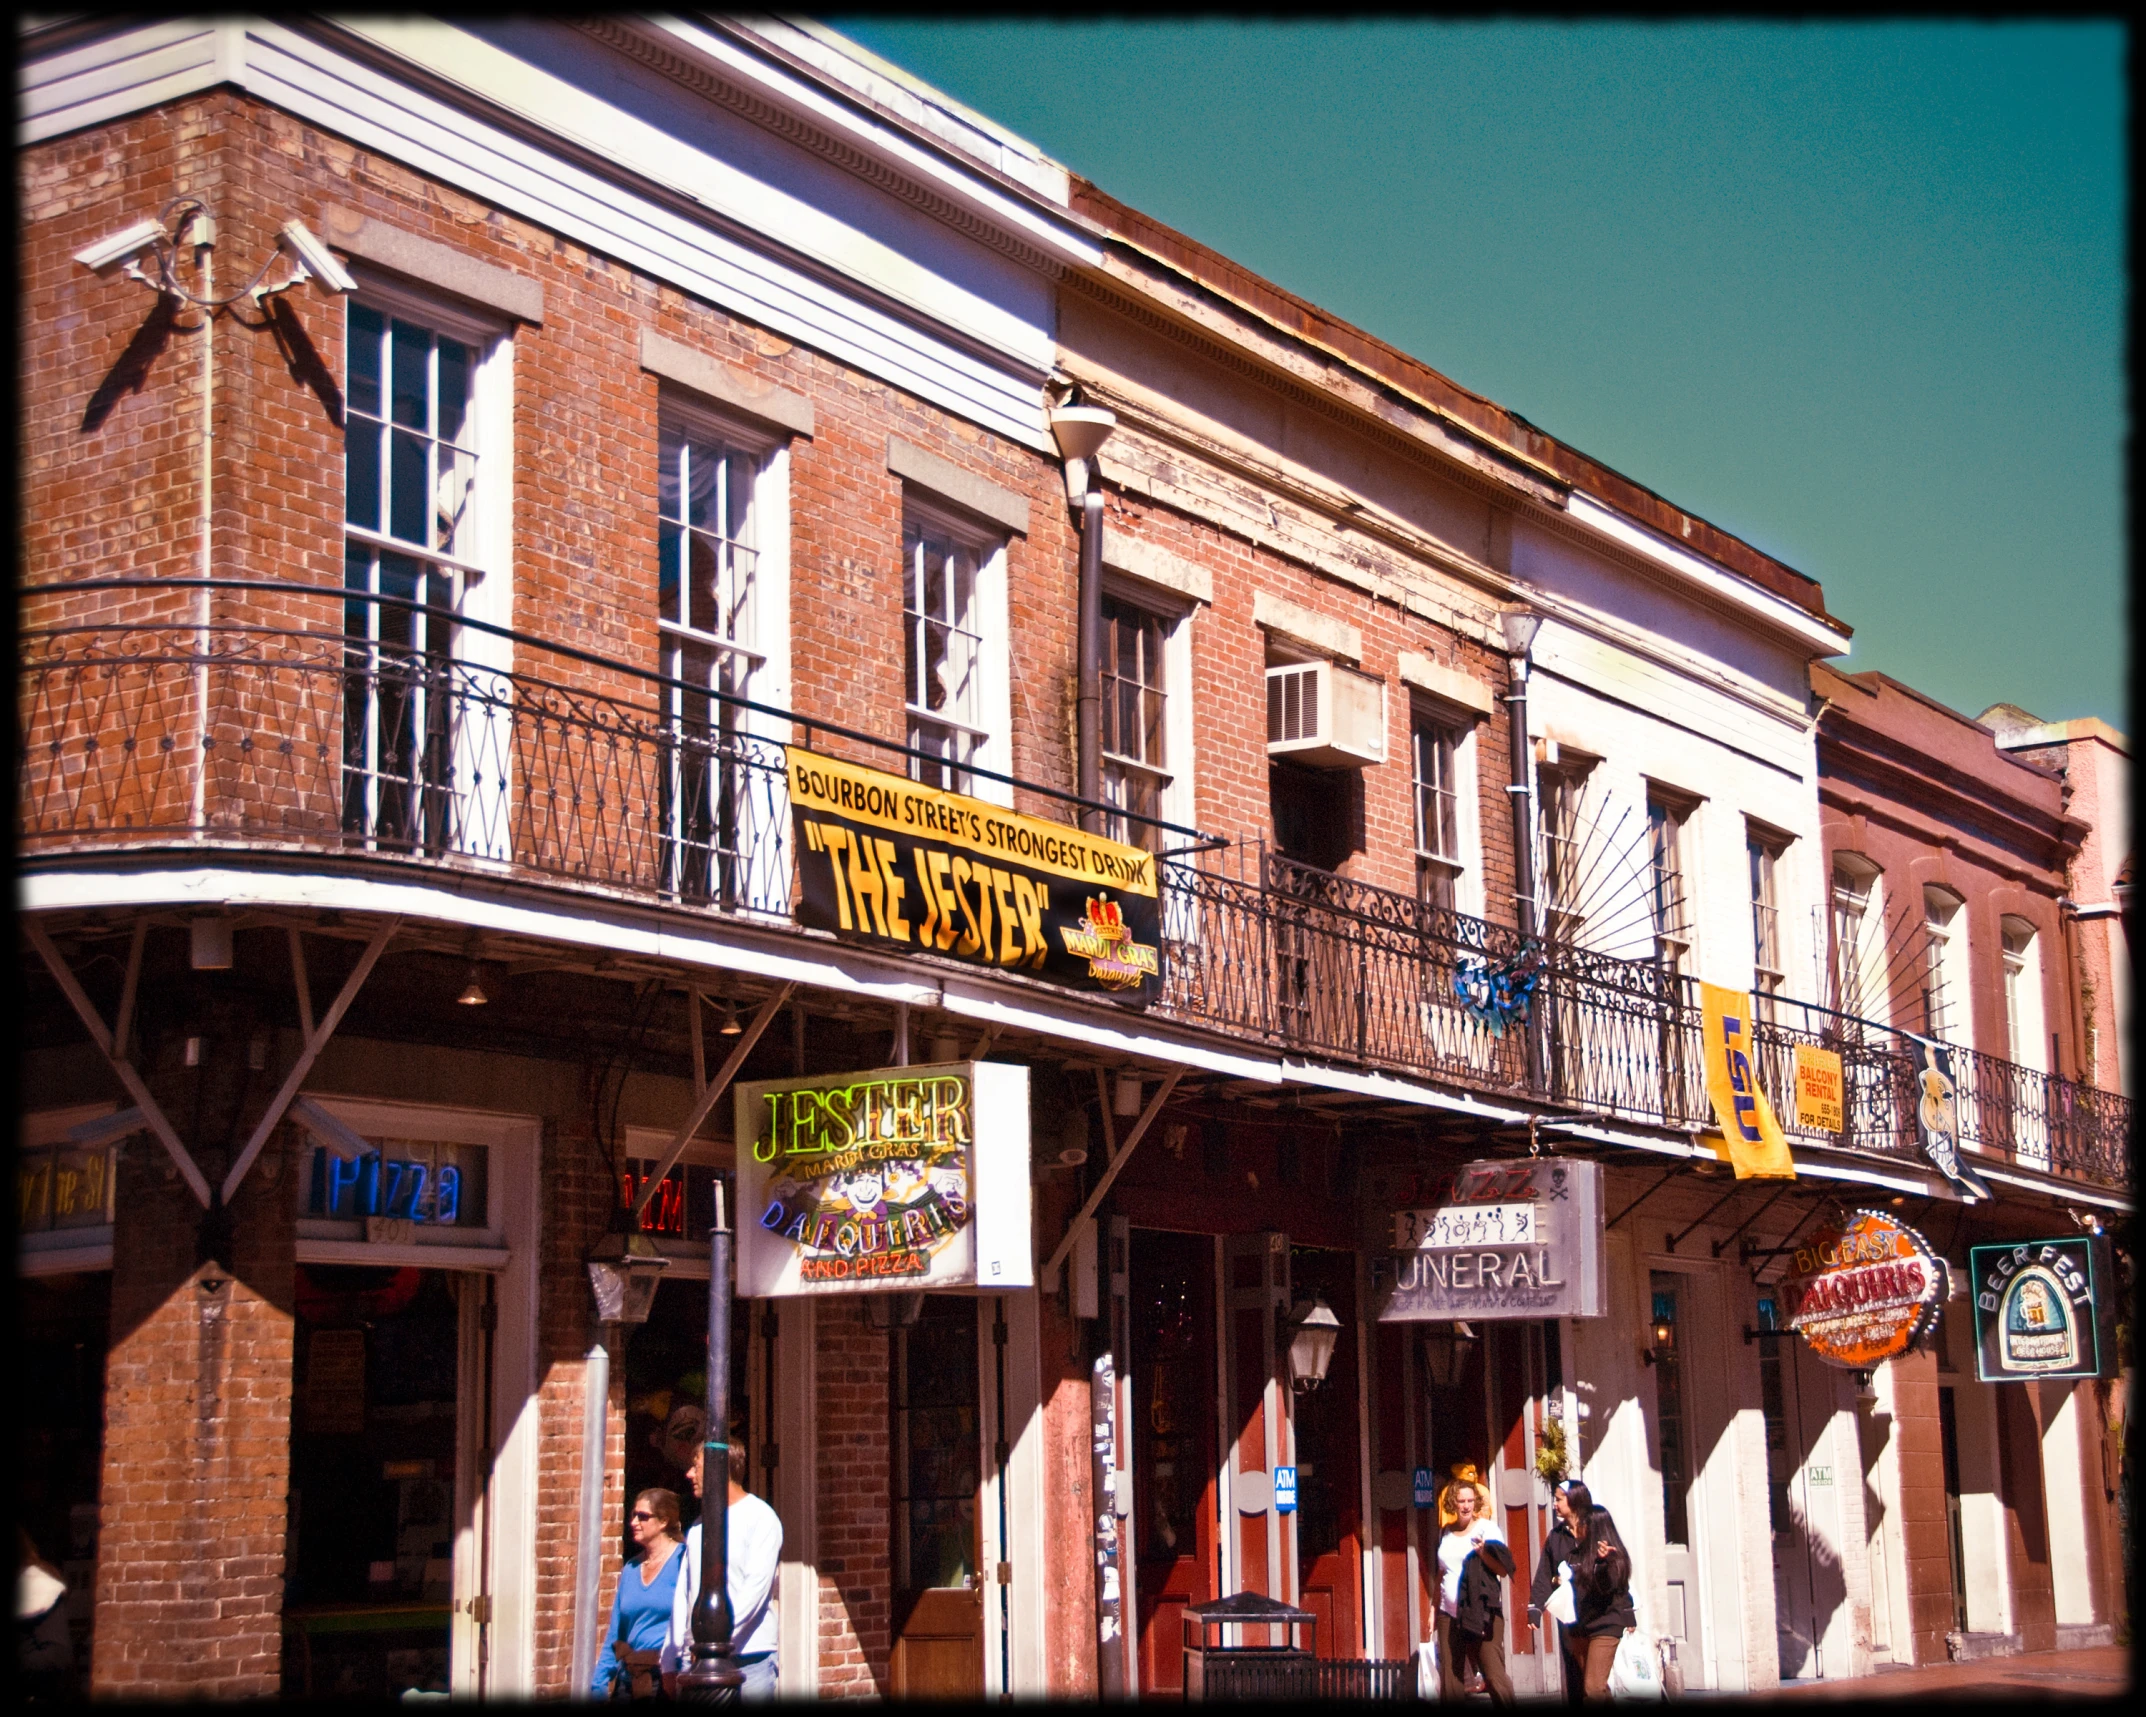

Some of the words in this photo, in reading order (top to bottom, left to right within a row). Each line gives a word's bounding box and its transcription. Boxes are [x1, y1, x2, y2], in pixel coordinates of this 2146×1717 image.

[796, 765, 898, 820] BOURBON
[905, 795, 980, 842] STREET'S
[987, 820, 1086, 871] STRONGEST
[1092, 852, 1148, 886] DRINK
[804, 820, 910, 942] "THE
[914, 847, 1049, 970] JESTER"
[1064, 931, 1111, 960] MARDI
[1117, 944, 1156, 971] GRAS
[1722, 1015, 1763, 1143] LSU
[1800, 1066, 1838, 1087] BALCONY
[1805, 1082, 1837, 1102] RENTAL
[754, 1076, 972, 1162] JESTER
[1800, 1113, 1814, 1125] FOR
[1817, 1115, 1841, 1131] DETAILS
[804, 1149, 863, 1180] MARDI
[869, 1141, 920, 1160] GRAS
[1395, 1168, 1538, 1204] JAZZ
[760, 1190, 969, 1257] DAIQUIRIS
[800, 1258, 848, 1278] AND
[855, 1253, 925, 1277] PIZZA
[1373, 1250, 1563, 1290] FUNERAL
[1795, 1241, 1838, 1273] BIG
[1841, 1230, 1901, 1264] EASY
[1782, 1262, 1926, 1315] DAIQUIRIS
[1978, 1246, 2032, 1312] BEER
[2039, 1245, 2093, 1306] FEST
[1275, 1469, 1295, 1488] ATM
[1415, 1470, 1433, 1487] ATM
[1810, 1467, 1831, 1480] ATM
